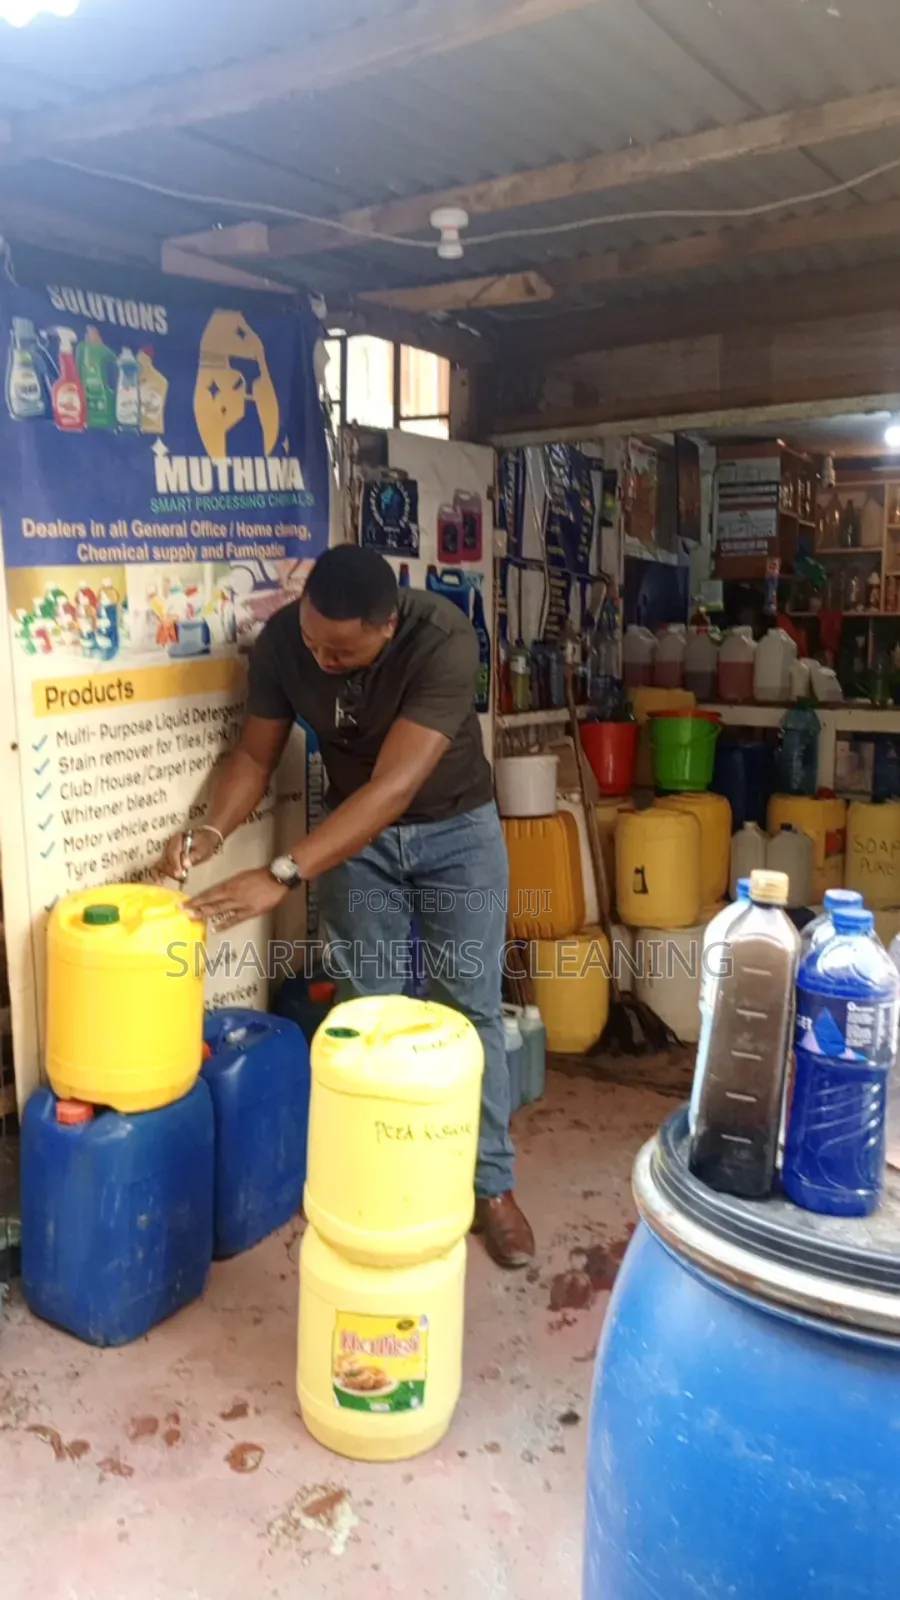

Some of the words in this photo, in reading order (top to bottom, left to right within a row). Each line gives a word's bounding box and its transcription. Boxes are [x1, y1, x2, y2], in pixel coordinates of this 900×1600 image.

[47, 284, 168, 335] SOLUTIONS
[150, 496, 193, 514] SMART
[195, 492, 266, 512] PROCESSING
[21, 517, 87, 539] Dealers
[90, 518, 106, 538] in
[109, 519, 128, 538] all
[131, 519, 188, 538] General
[190, 520, 228, 538] Office
[236, 521, 273, 538] Home
[77, 542, 149, 562] Chemical
[152, 542, 199, 564] supply
[201, 542, 224, 560] and
[45, 677, 134, 711] Products
[56, 724, 96, 748] Multi-
[99, 718, 153, 741] Purpose
[154, 706, 190, 732] Liquid
[58, 752, 97, 776] Stain
[99, 743, 153, 769] remover
[156, 736, 172, 756] for
[60, 800, 123, 827] Whitener
[125, 786, 168, 812] bleach
[62, 830, 104, 855] Motor
[105, 817, 150, 843] vehicle
[65, 858, 98, 881] Tyre
